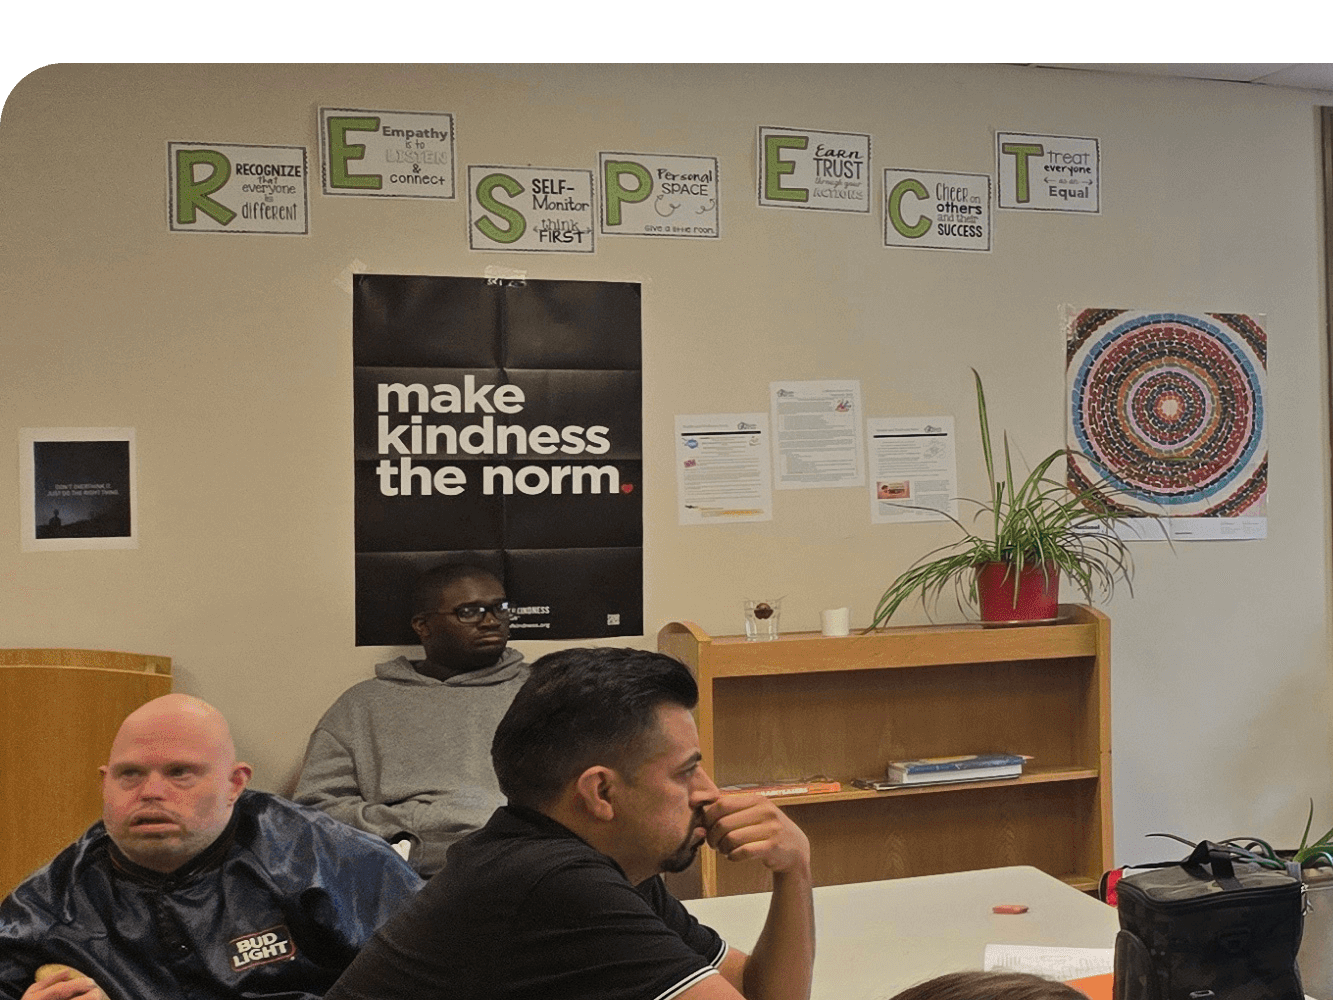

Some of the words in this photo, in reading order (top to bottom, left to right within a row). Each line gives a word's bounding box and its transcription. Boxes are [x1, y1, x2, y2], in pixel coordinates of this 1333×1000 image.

[382, 126, 449, 142] Empathy
[327, 115, 383, 190] E
[814, 144, 864, 159] Earn
[1046, 150, 1091, 165] treat
[235, 163, 302, 177] RECOGNIZE
[412, 163, 422, 173] &
[657, 168, 713, 184] Personal
[764, 134, 810, 203] E
[812, 157, 864, 179] TRUST
[1001, 142, 1045, 204] T
[1043, 164, 1092, 177] everyone
[176, 149, 237, 226] R
[389, 173, 446, 185] connect
[531, 178, 575, 195] SELF-
[241, 183, 297, 195] everyone
[604, 159, 654, 227] P
[661, 182, 709, 196] SPACE
[935, 182, 969, 202] Cheer
[1048, 185, 1090, 201] Equal
[241, 202, 298, 220] different
[473, 172, 527, 244] S
[531, 194, 590, 212] Monitor
[888, 178, 933, 239] C
[936, 201, 983, 215] others
[541, 217, 580, 232] think
[937, 223, 983, 238] SUCCESS
[538, 230, 584, 244] FIRST
[377, 374, 526, 414] make
[377, 414, 611, 456] kindness
[375, 456, 467, 497] the
[482, 464, 621, 496] norm
[235, 932, 278, 954] BUD
[232, 940, 289, 967] LIGHT
